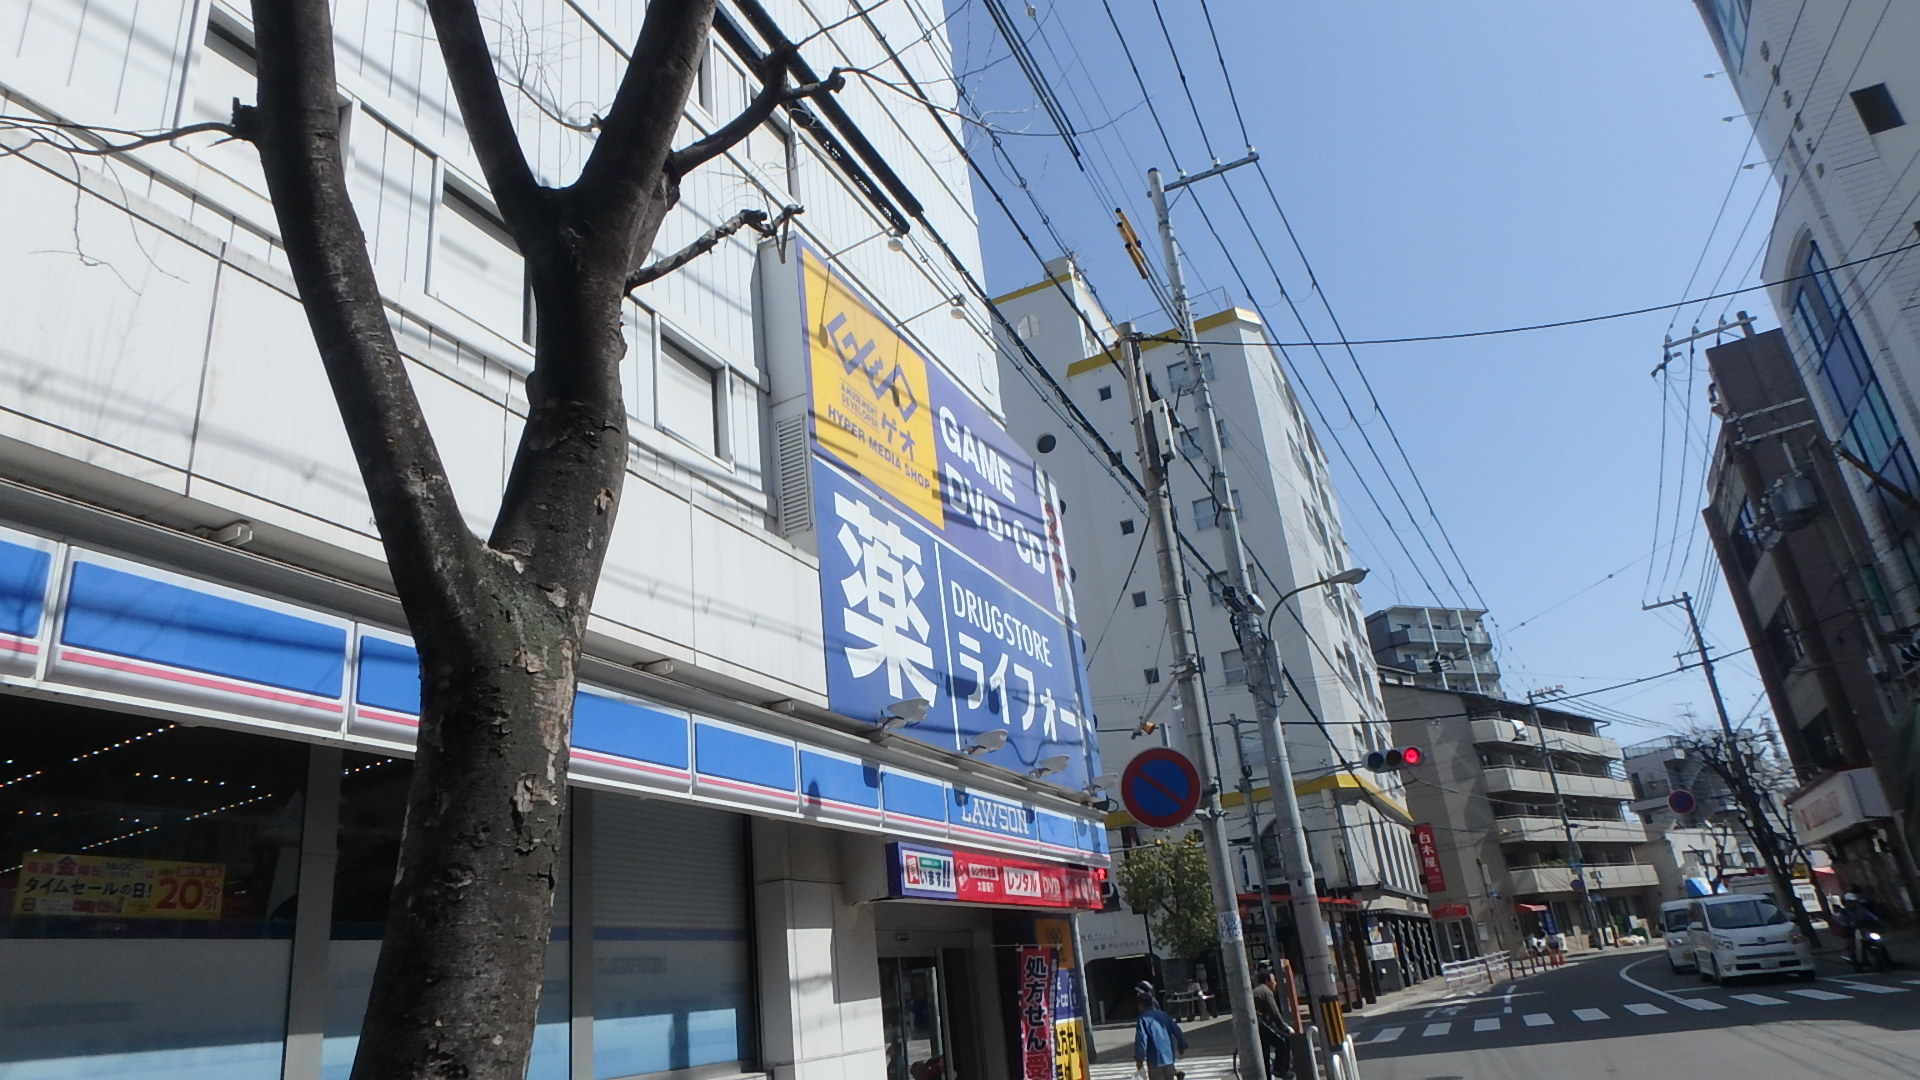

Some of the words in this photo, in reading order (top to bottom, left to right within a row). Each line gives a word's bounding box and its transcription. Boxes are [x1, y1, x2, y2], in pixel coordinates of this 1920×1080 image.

[840, 382, 878, 418] AMUSEMENT
[841, 393, 879, 430] DEVELOPER
[828, 404, 867, 444] HYPER
[868, 436, 902, 471] MEDIA
[904, 462, 932, 490] SHOP
[881, 410, 916, 463] ゲオ
[939, 405, 1017, 505] GAME
[834, 490, 938, 708] 薬
[950, 578, 1054, 669] DRUGSTORE
[961, 797, 1030, 836] LAWSON
[1419, 832, 1437, 868] 白木屋
[1007, 869, 1037, 892] レンタル
